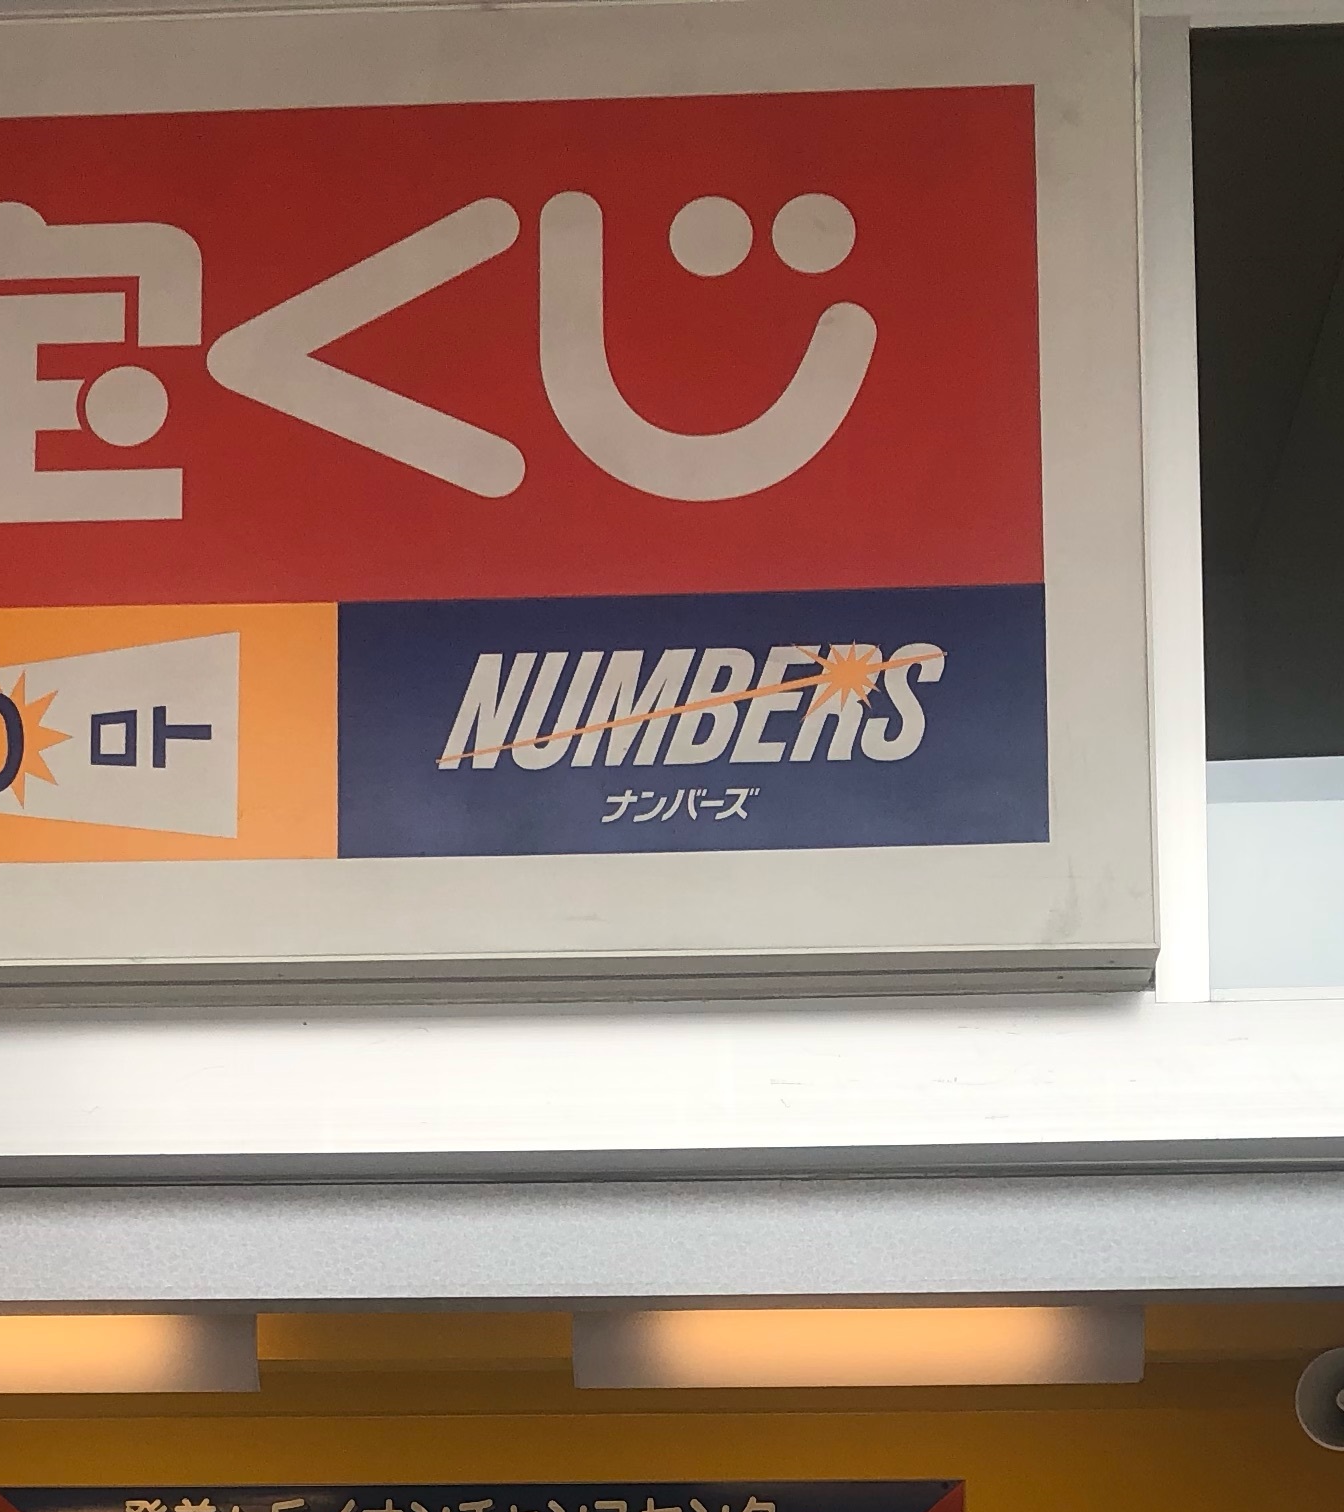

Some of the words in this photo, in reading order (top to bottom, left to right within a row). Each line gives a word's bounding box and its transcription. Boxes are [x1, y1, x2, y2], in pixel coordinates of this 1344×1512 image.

[438, 642, 946, 771] NUMBERS
[90, 707, 212, 768] ロト
[601, 786, 760, 822] ナンバーズ
